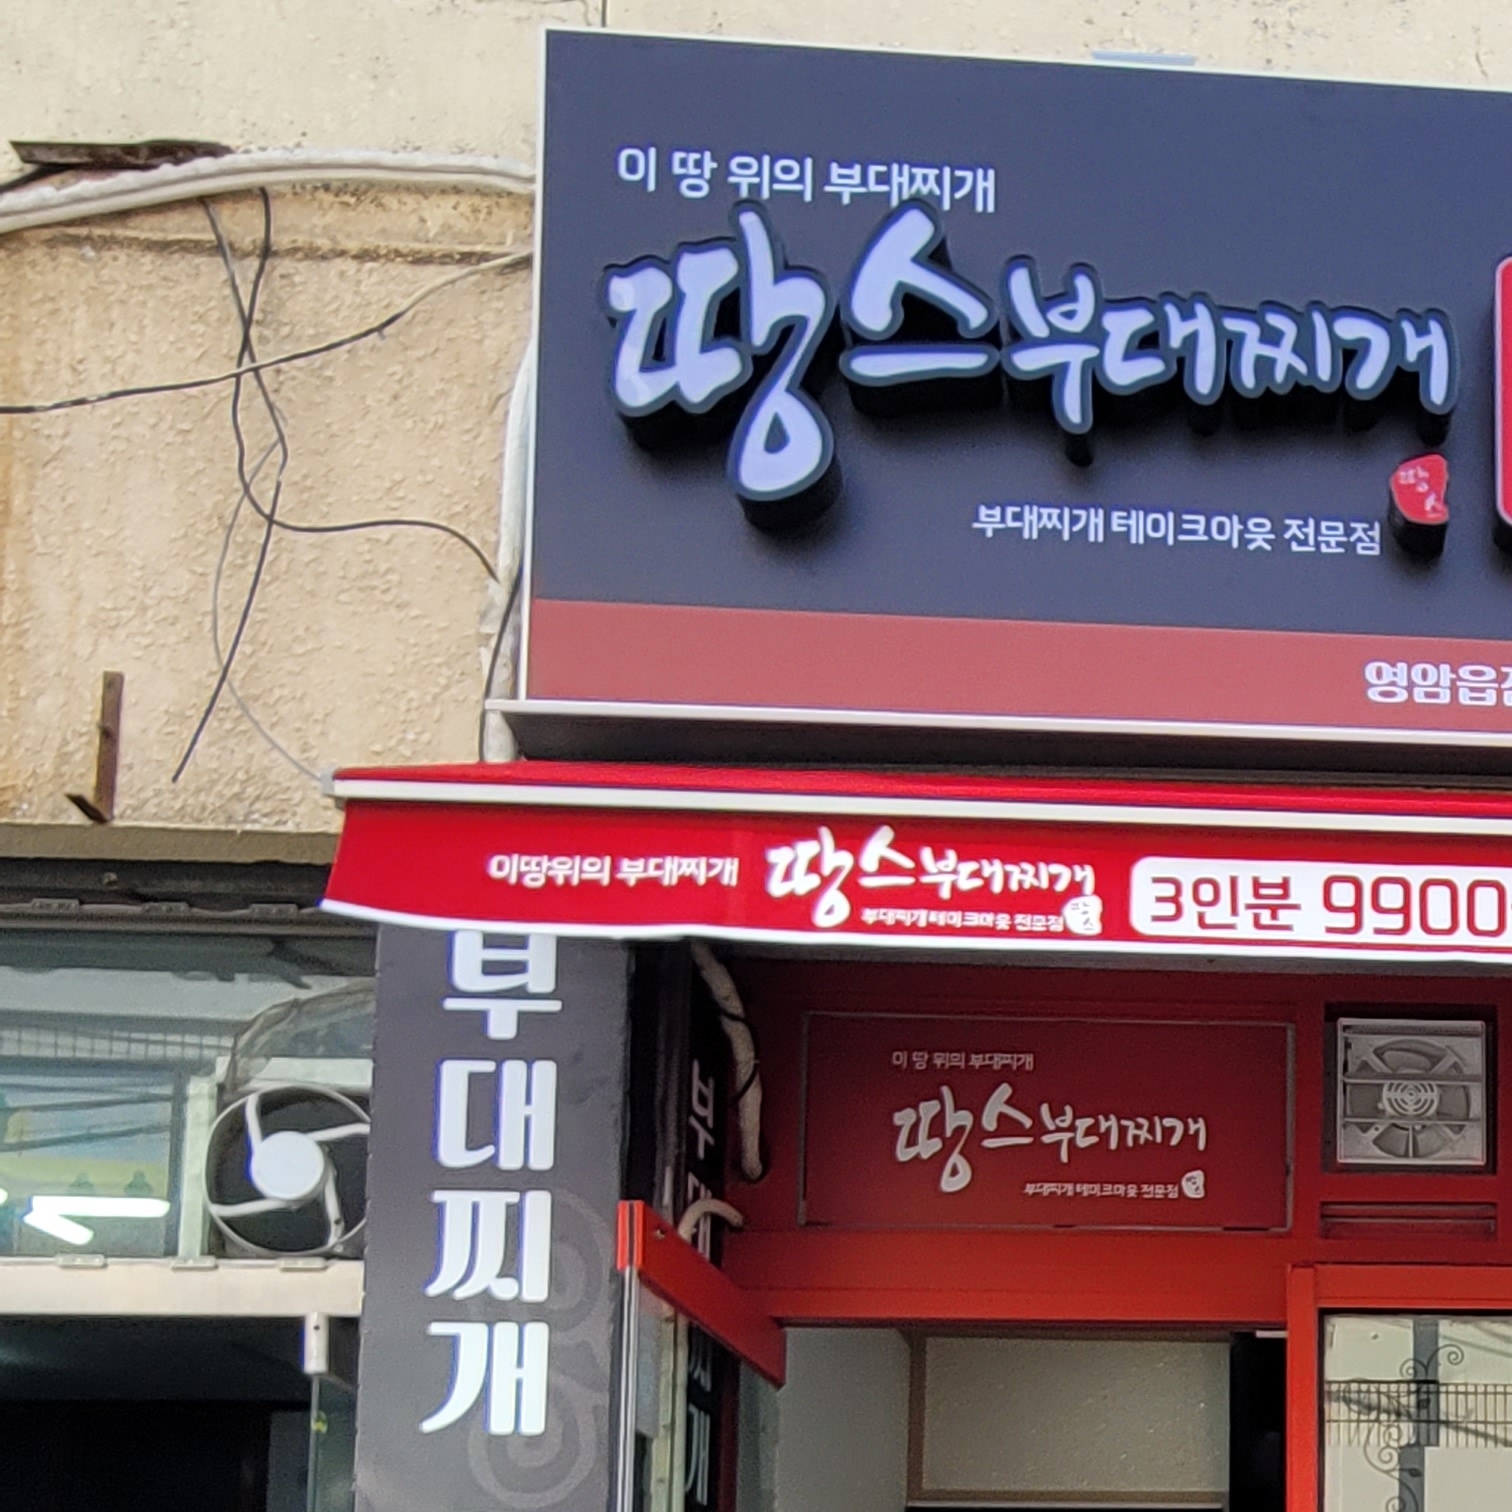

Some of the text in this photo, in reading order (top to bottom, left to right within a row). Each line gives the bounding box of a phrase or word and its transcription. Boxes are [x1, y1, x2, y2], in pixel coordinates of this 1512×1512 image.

[618, 146, 997, 213] 이 땅 위의 부대찌개
[972, 504, 1382, 556] 부대찌개 테이크아웃 전문점
[487, 853, 739, 888] 이땅위의 부대찌개
[860, 907, 927, 928] 부대찌개
[1149, 873, 1302, 933] 3인분
[891, 1050, 1035, 1073] 이 땅 위의 부대찌개
[419, 928, 563, 1436] 부대찌개
